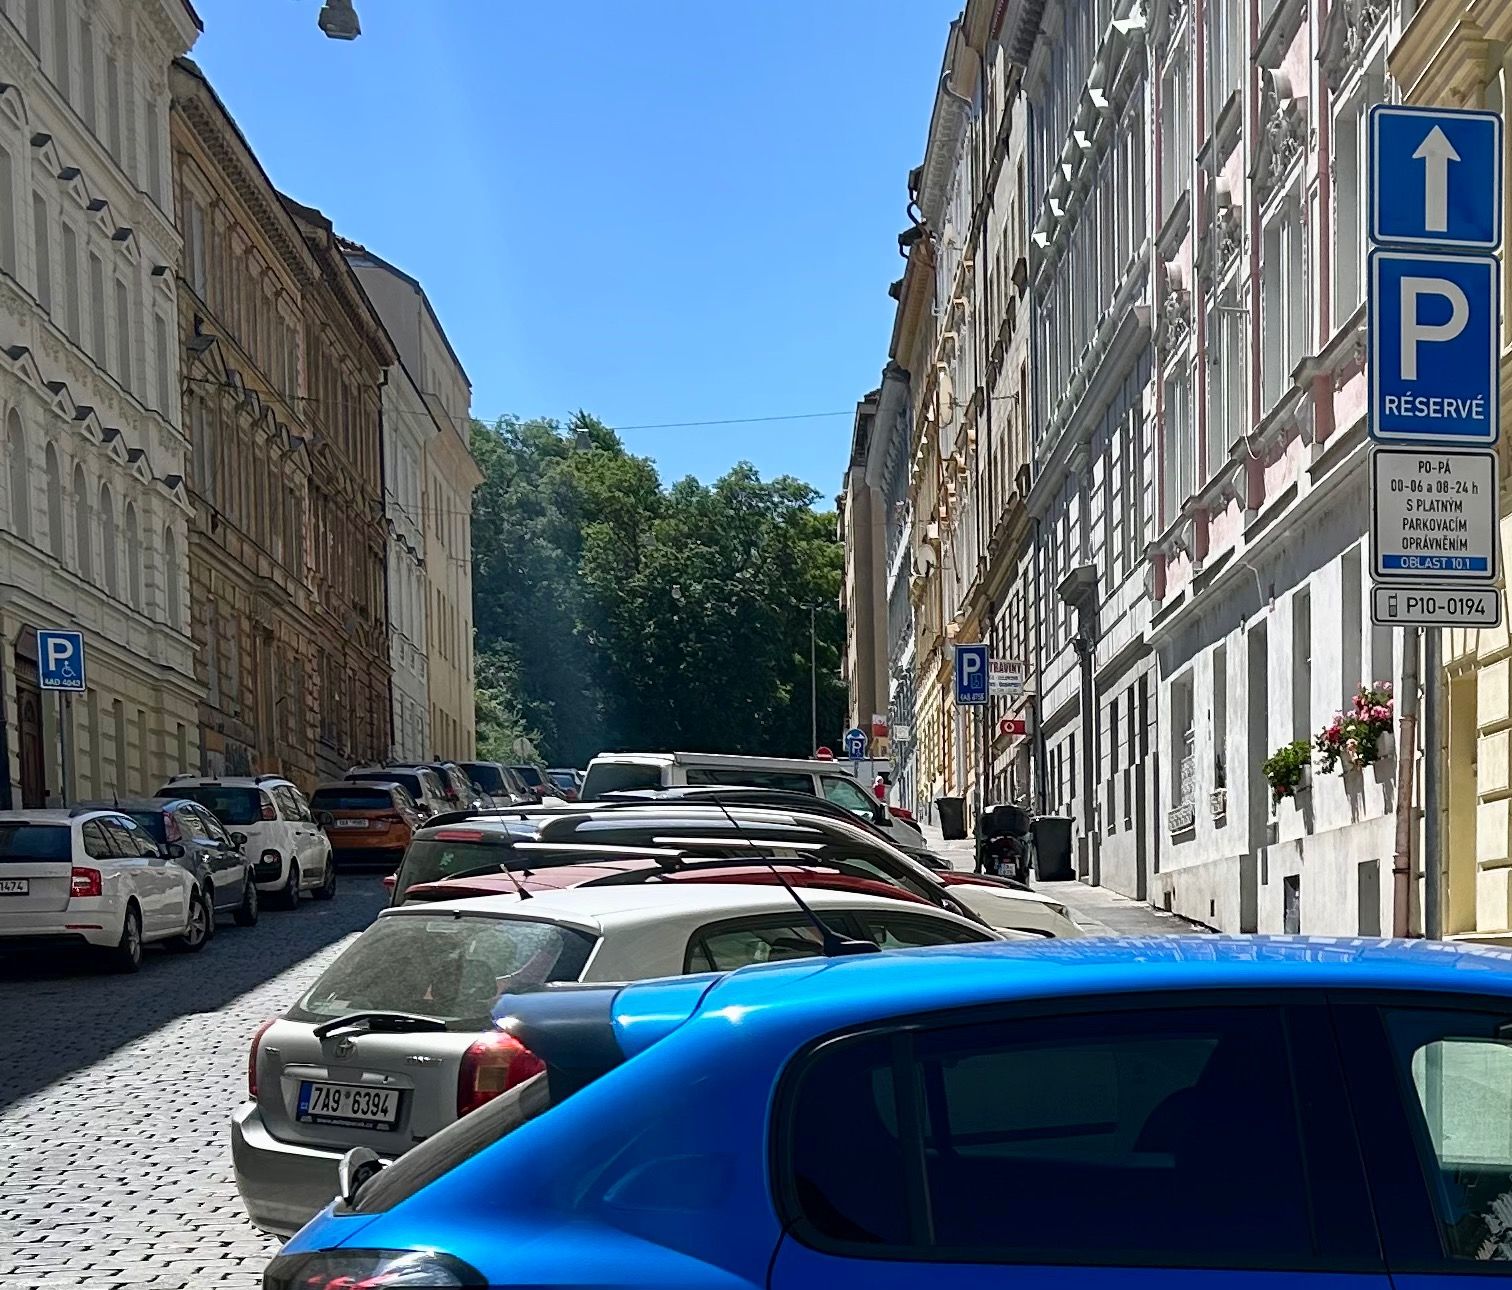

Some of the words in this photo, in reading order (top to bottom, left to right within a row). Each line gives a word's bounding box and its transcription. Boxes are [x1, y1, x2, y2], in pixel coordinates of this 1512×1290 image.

[1400, 275, 1470, 381] P
[1384, 391, 1485, 420] RÉSERVÉ
[1418, 458, 1451, 475] PO-PÁ
[1390, 479, 1423, 493] 00-06
[1426, 483, 1432, 493] a
[1436, 480, 1469, 494] 08-24
[1472, 481, 1478, 495] h
[1406, 499, 1413, 512] S
[1416, 497, 1463, 513] PLATNÝM
[1402, 517, 1467, 532] PARKOVACÍM
[1402, 534, 1468, 551] OPRÁVNĚNÍM
[1401, 557, 1447, 569] OBLAST
[1450, 558, 1470, 570] 10.1
[1406, 597, 1486, 616] P10-0194
[47, 637, 74, 671] P
[962, 652, 981, 686] P
[852, 740, 862, 754] P
[311, 1087, 342, 1112] 7A9
[351, 1091, 390, 1118] 6394
